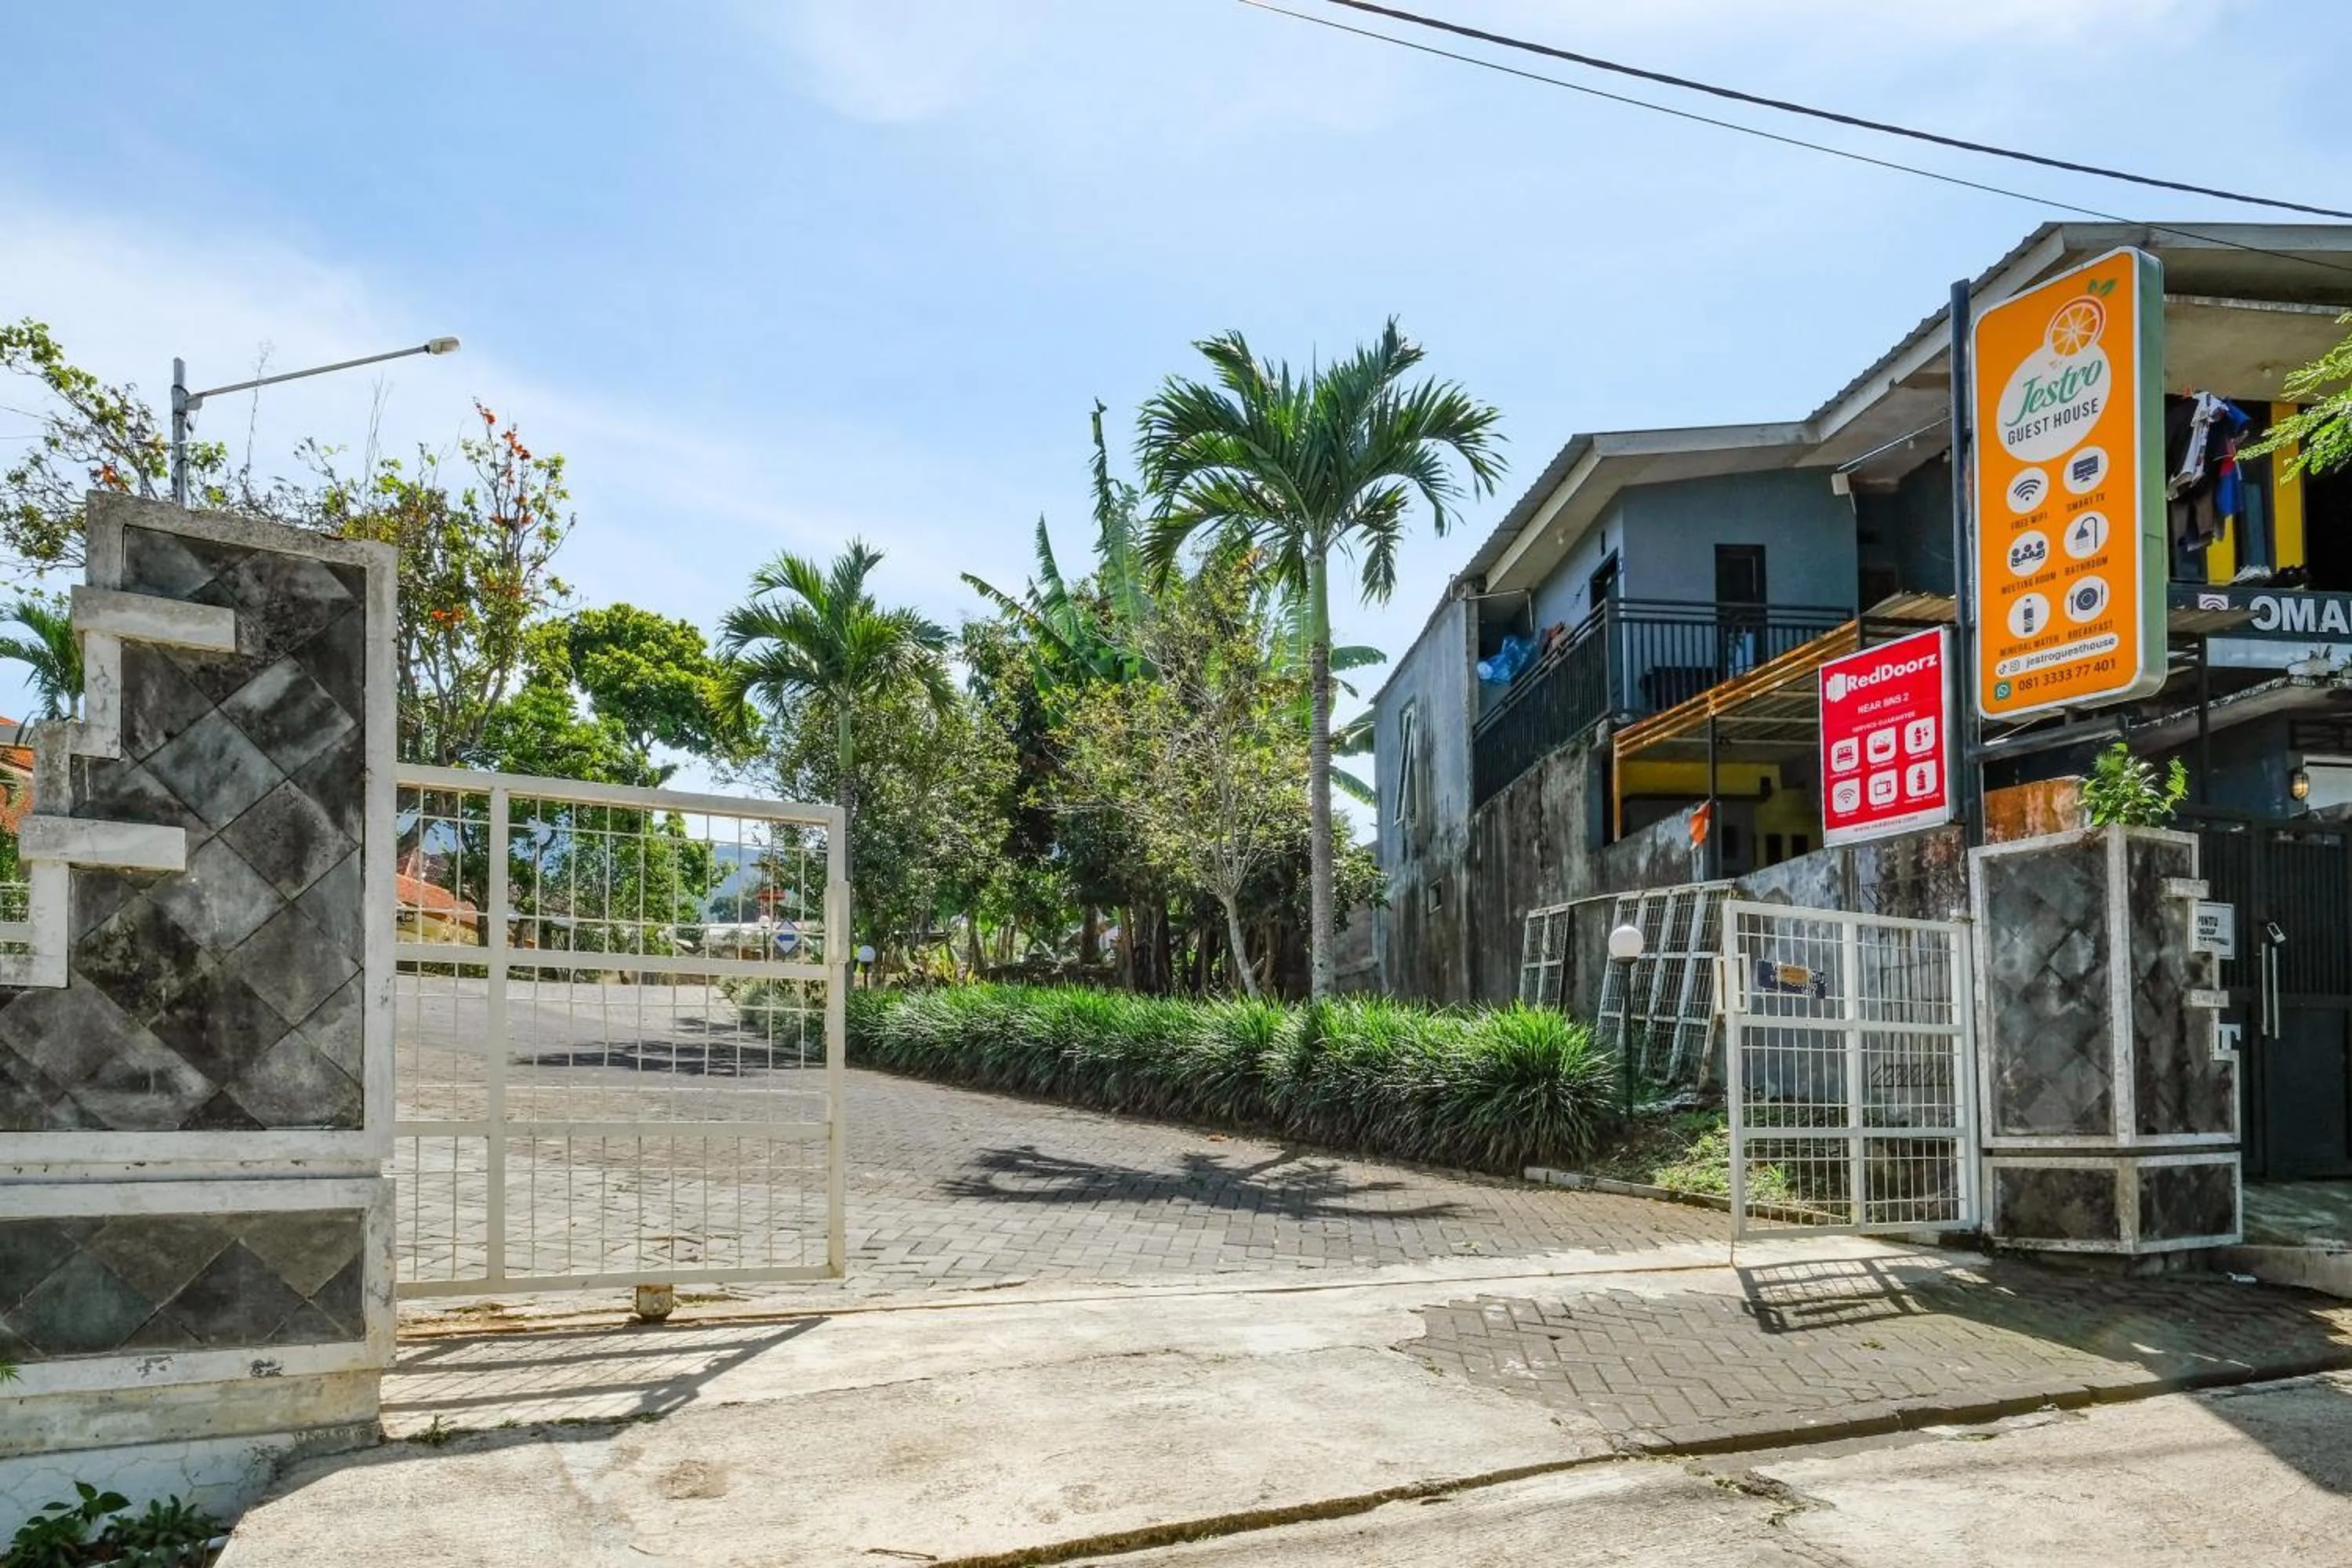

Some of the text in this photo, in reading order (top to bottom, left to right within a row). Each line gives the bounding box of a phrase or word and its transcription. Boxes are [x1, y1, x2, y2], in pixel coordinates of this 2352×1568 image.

[2005, 359, 2103, 427] Jestro
[2008, 397, 2099, 445] GUEST HOUSE
[2067, 492, 2105, 513] SMART TV
[2011, 518, 2028, 532] FREE
[2064, 556, 2108, 575] BATHROOM
[2001, 571, 2056, 595] MEETING ROOM
[2249, 595, 2352, 633] OMA
[2067, 619, 2113, 640] BREAKFAST
[1999, 635, 2060, 657] MINERAL WATER
[2026, 637, 2115, 668] jestroguesthouse
[1846, 652, 1937, 691] RedDoorz
[2018, 658, 2116, 691] 081 3333 77 401
[1857, 700, 1882, 715] NEAR
[1902, 691, 1910, 702] 2
